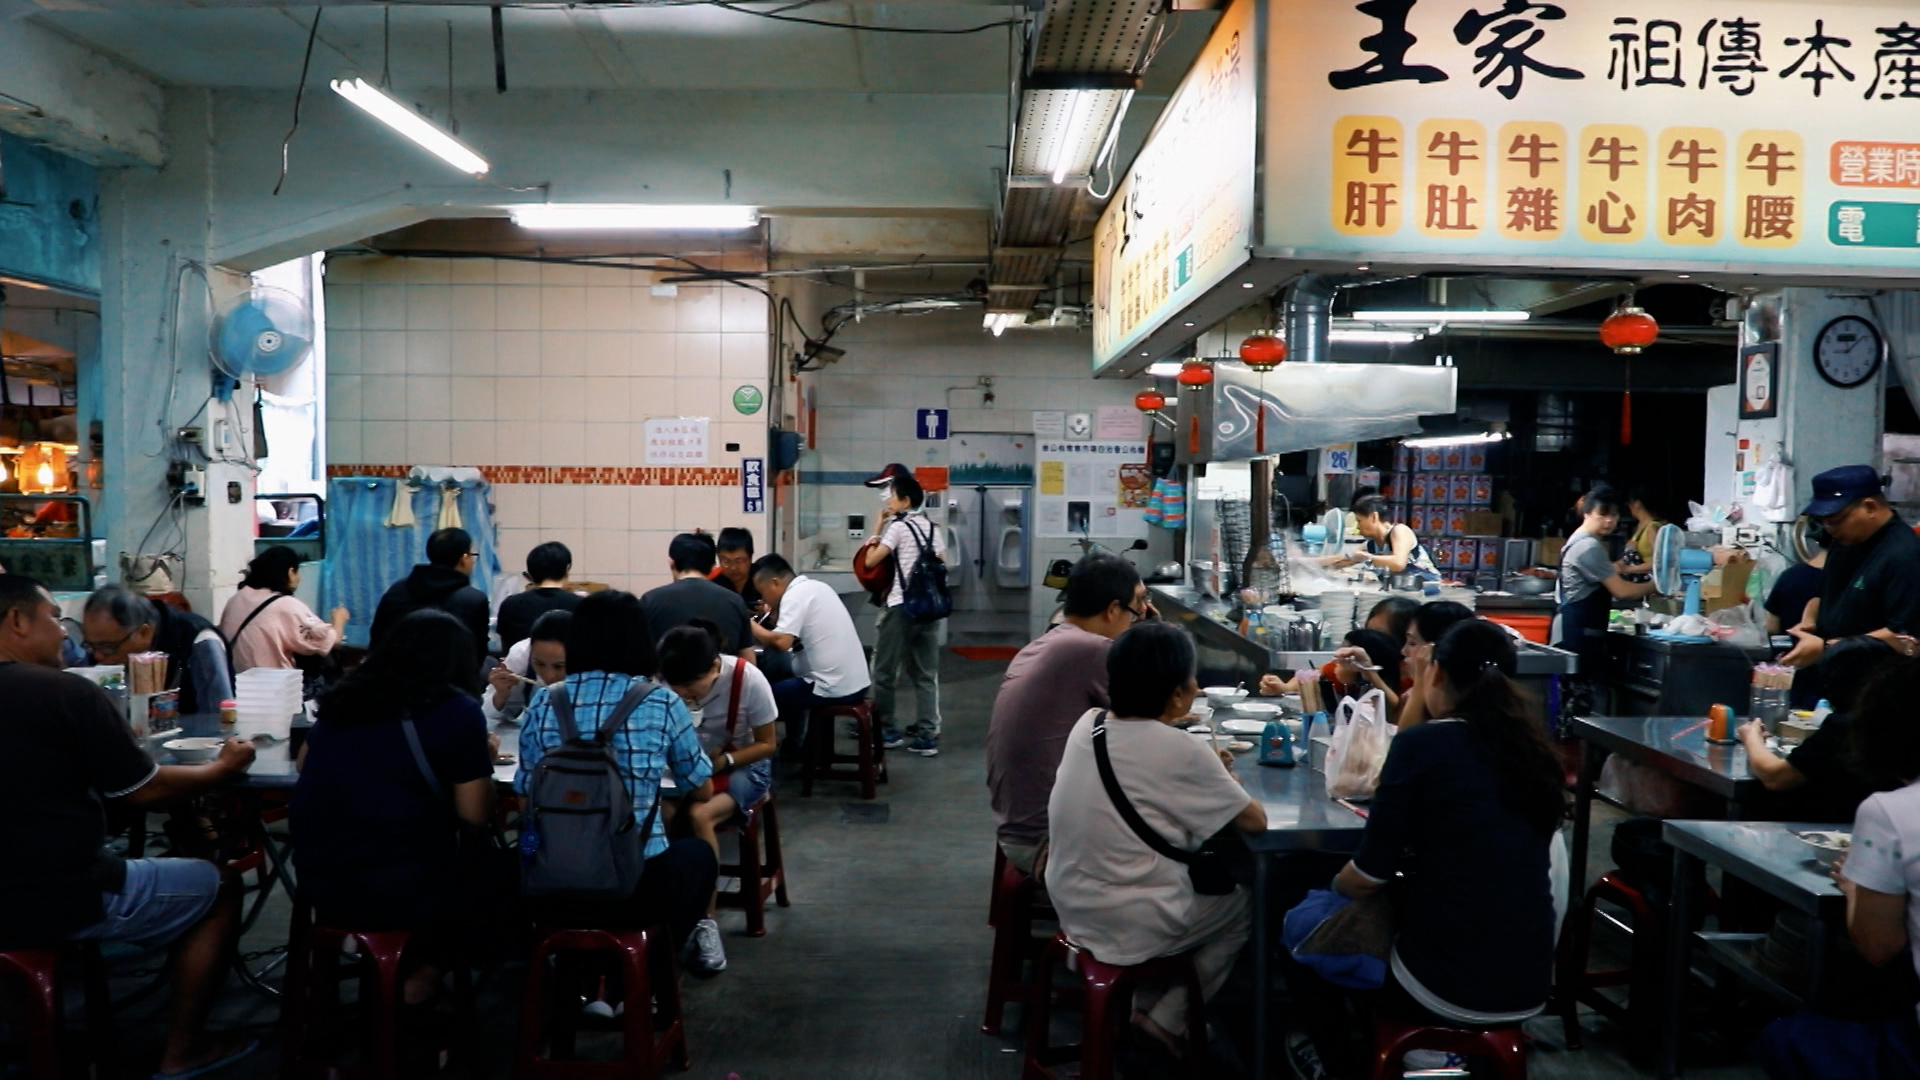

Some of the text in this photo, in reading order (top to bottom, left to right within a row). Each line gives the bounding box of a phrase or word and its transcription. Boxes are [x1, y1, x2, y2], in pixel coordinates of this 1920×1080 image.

[1328, 0, 1585, 100] 王家
[1607, 16, 1920, 100] 祖傳本產
[1345, 128, 1399, 228] 牛肝
[1426, 131, 1479, 230] 牛肚
[1506, 133, 1560, 232] 牛雜
[1587, 137, 1639, 234] 牛心
[1666, 139, 1718, 238] 牛肉
[1744, 142, 1796, 240] 牛腰
[1839, 145, 1920, 186] 營業時
